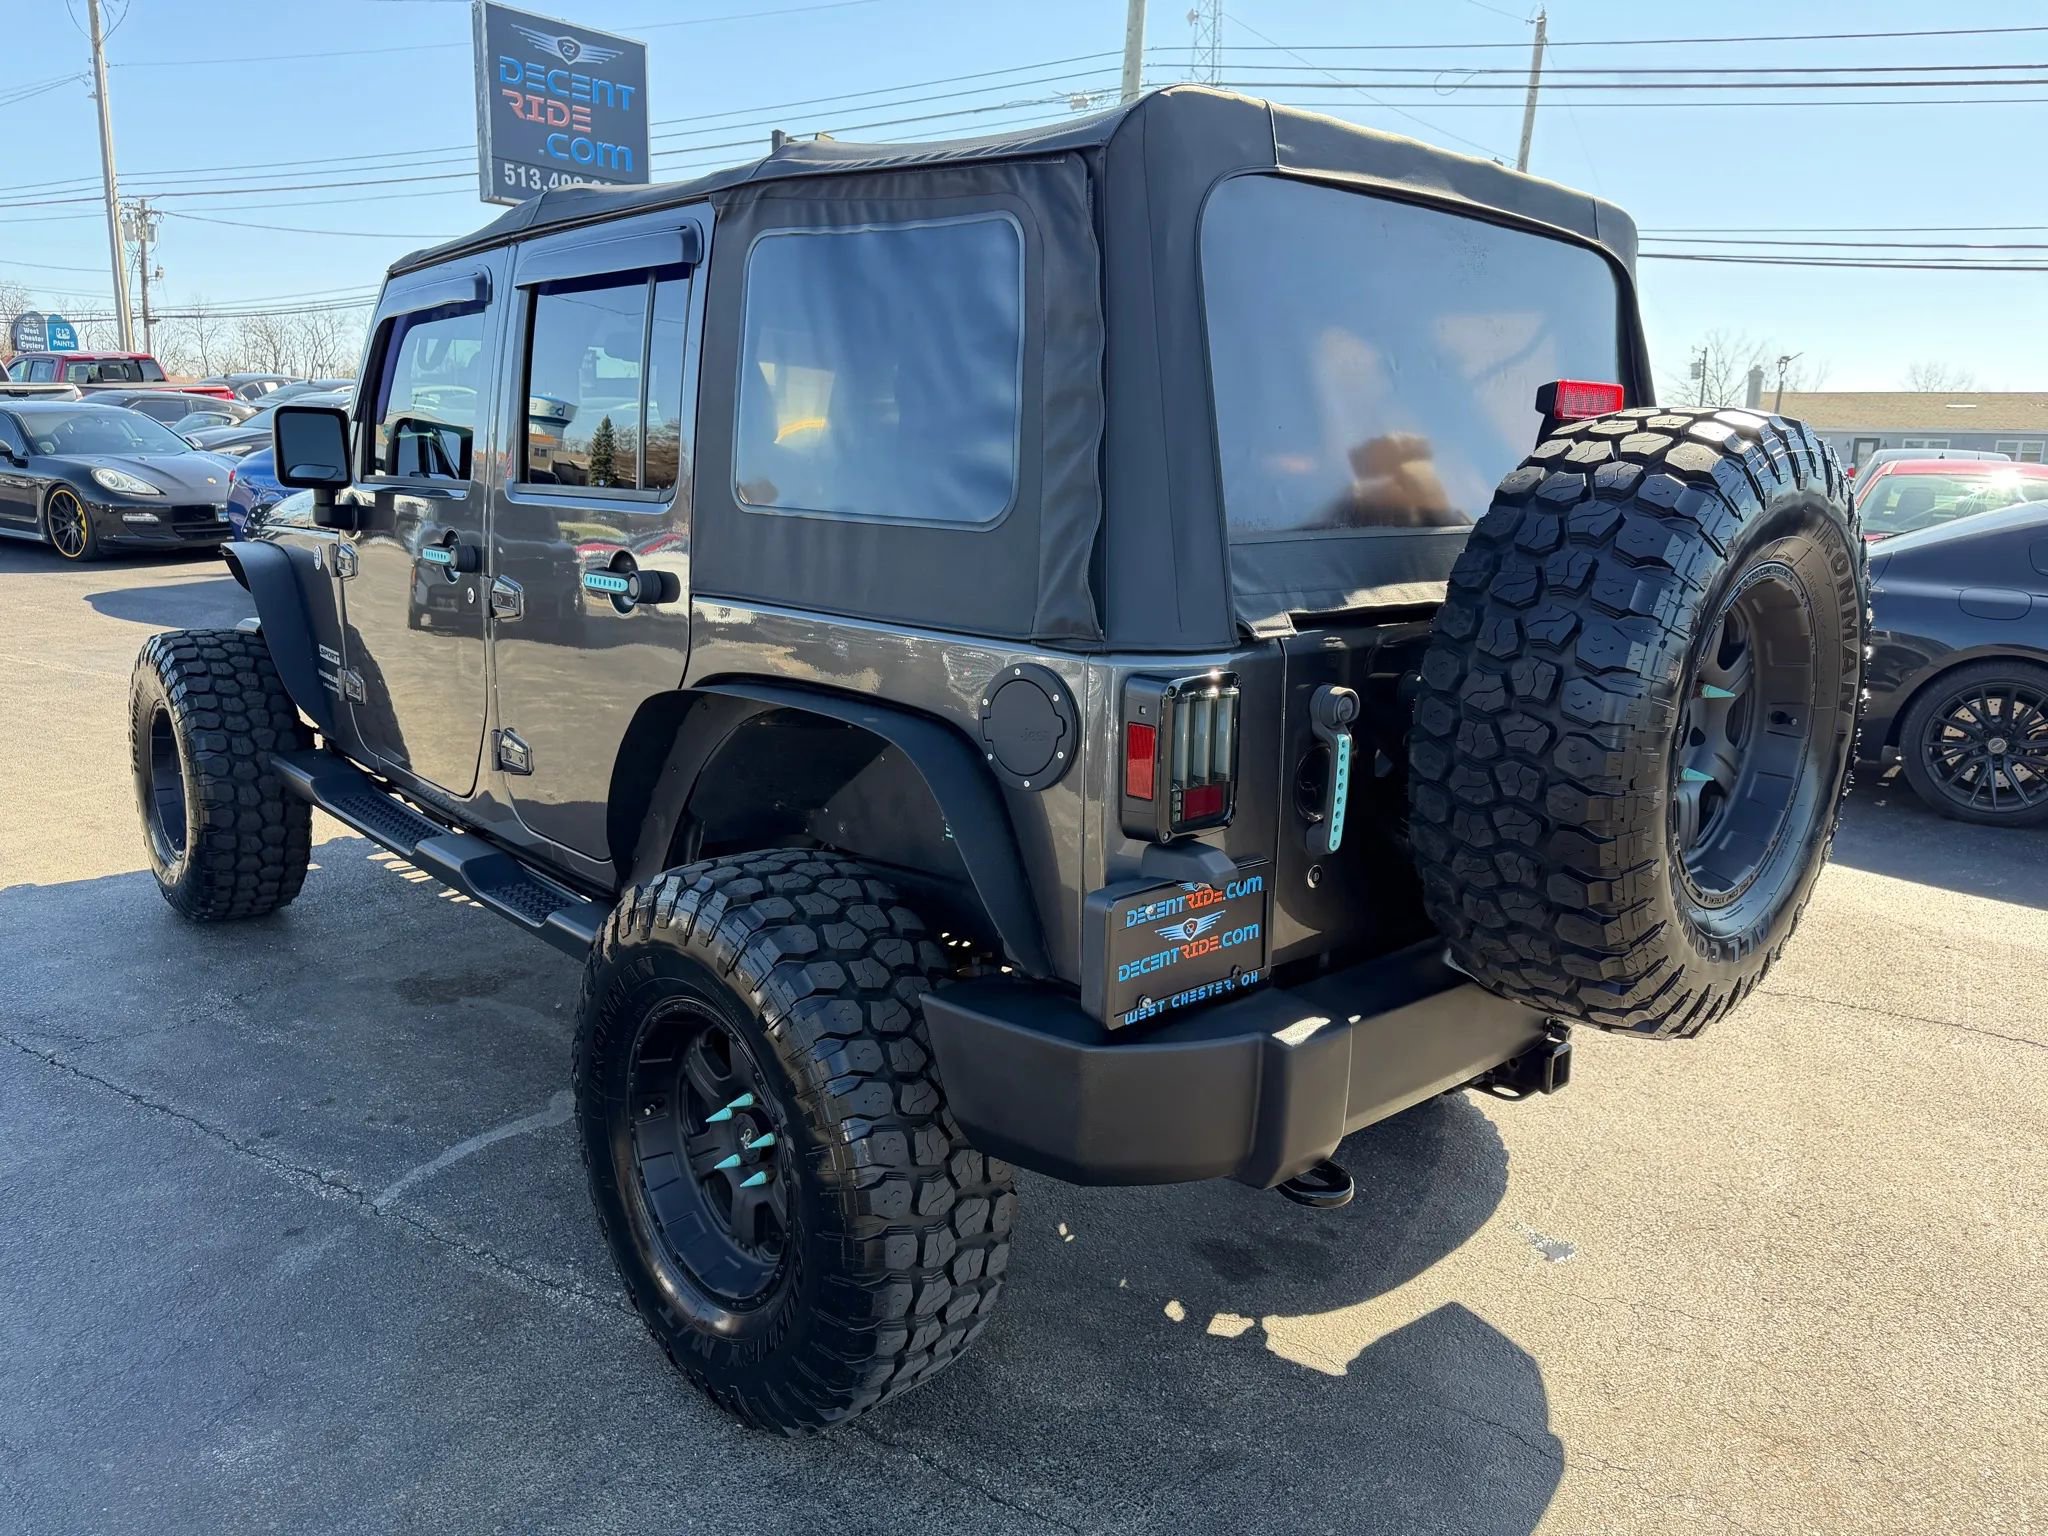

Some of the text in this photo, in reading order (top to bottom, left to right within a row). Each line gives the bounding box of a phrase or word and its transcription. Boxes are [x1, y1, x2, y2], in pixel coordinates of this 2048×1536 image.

[499, 55, 636, 112] DECENT
[502, 88, 592, 134] RIDE
[20, 334, 44, 342] Chester
[20, 341, 45, 350] Cyclery
[23, 327, 40, 335] West
[52, 339, 75, 348] PAINTS
[1812, 518, 1859, 715] IRONMAN
[320, 647, 339, 662] SPORT
[131, 679, 145, 774] IRONMAN
[1124, 999, 1165, 1025] WEST
[1241, 970, 1259, 986] OH
